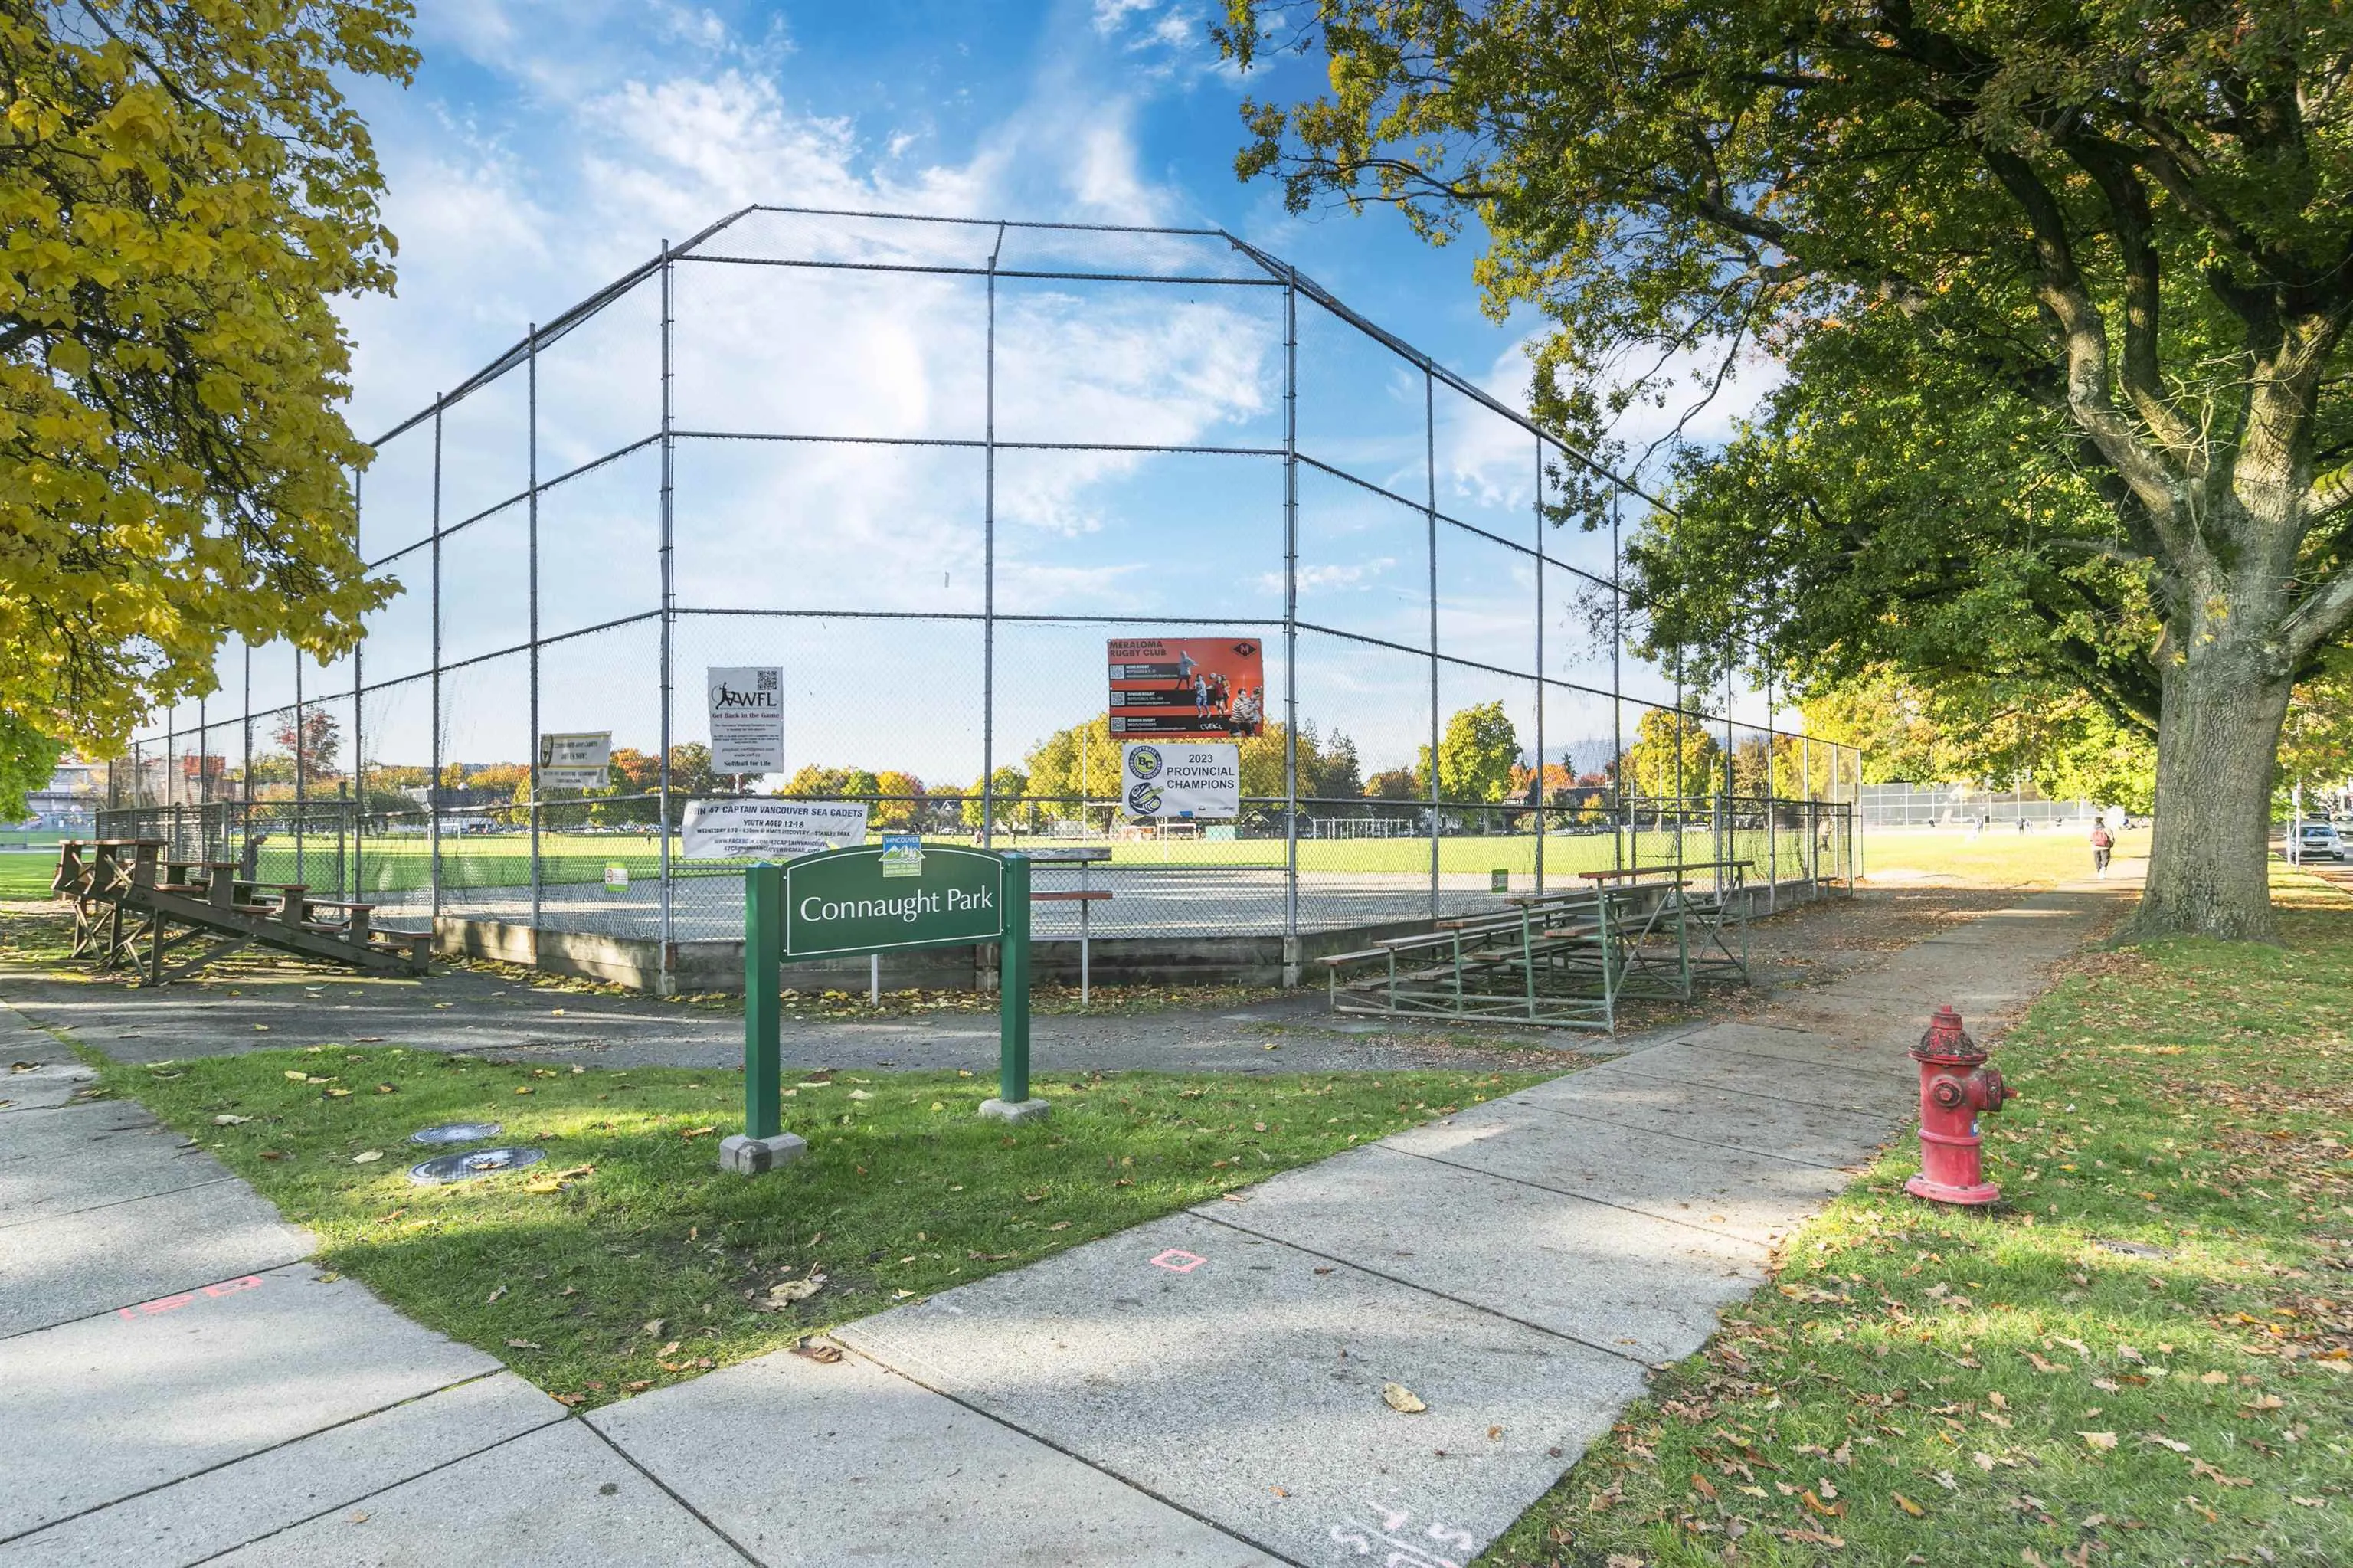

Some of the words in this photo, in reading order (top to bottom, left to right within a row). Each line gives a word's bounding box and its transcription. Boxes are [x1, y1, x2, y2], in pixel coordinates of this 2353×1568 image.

[1110, 640, 1163, 649] MERALOMA
[1143, 648, 1167, 656] CLUB
[1189, 754, 1213, 763] 2023
[1167, 767, 1235, 776] PROVINCIAL
[1167, 780, 1235, 789] CHAMPIONS
[722, 805, 757, 813] CAPTAIN
[760, 807, 809, 816] VANCOUVER
[830, 809, 863, 817] CADETS
[800, 889, 940, 922] Connaught
[947, 885, 993, 912] Park
